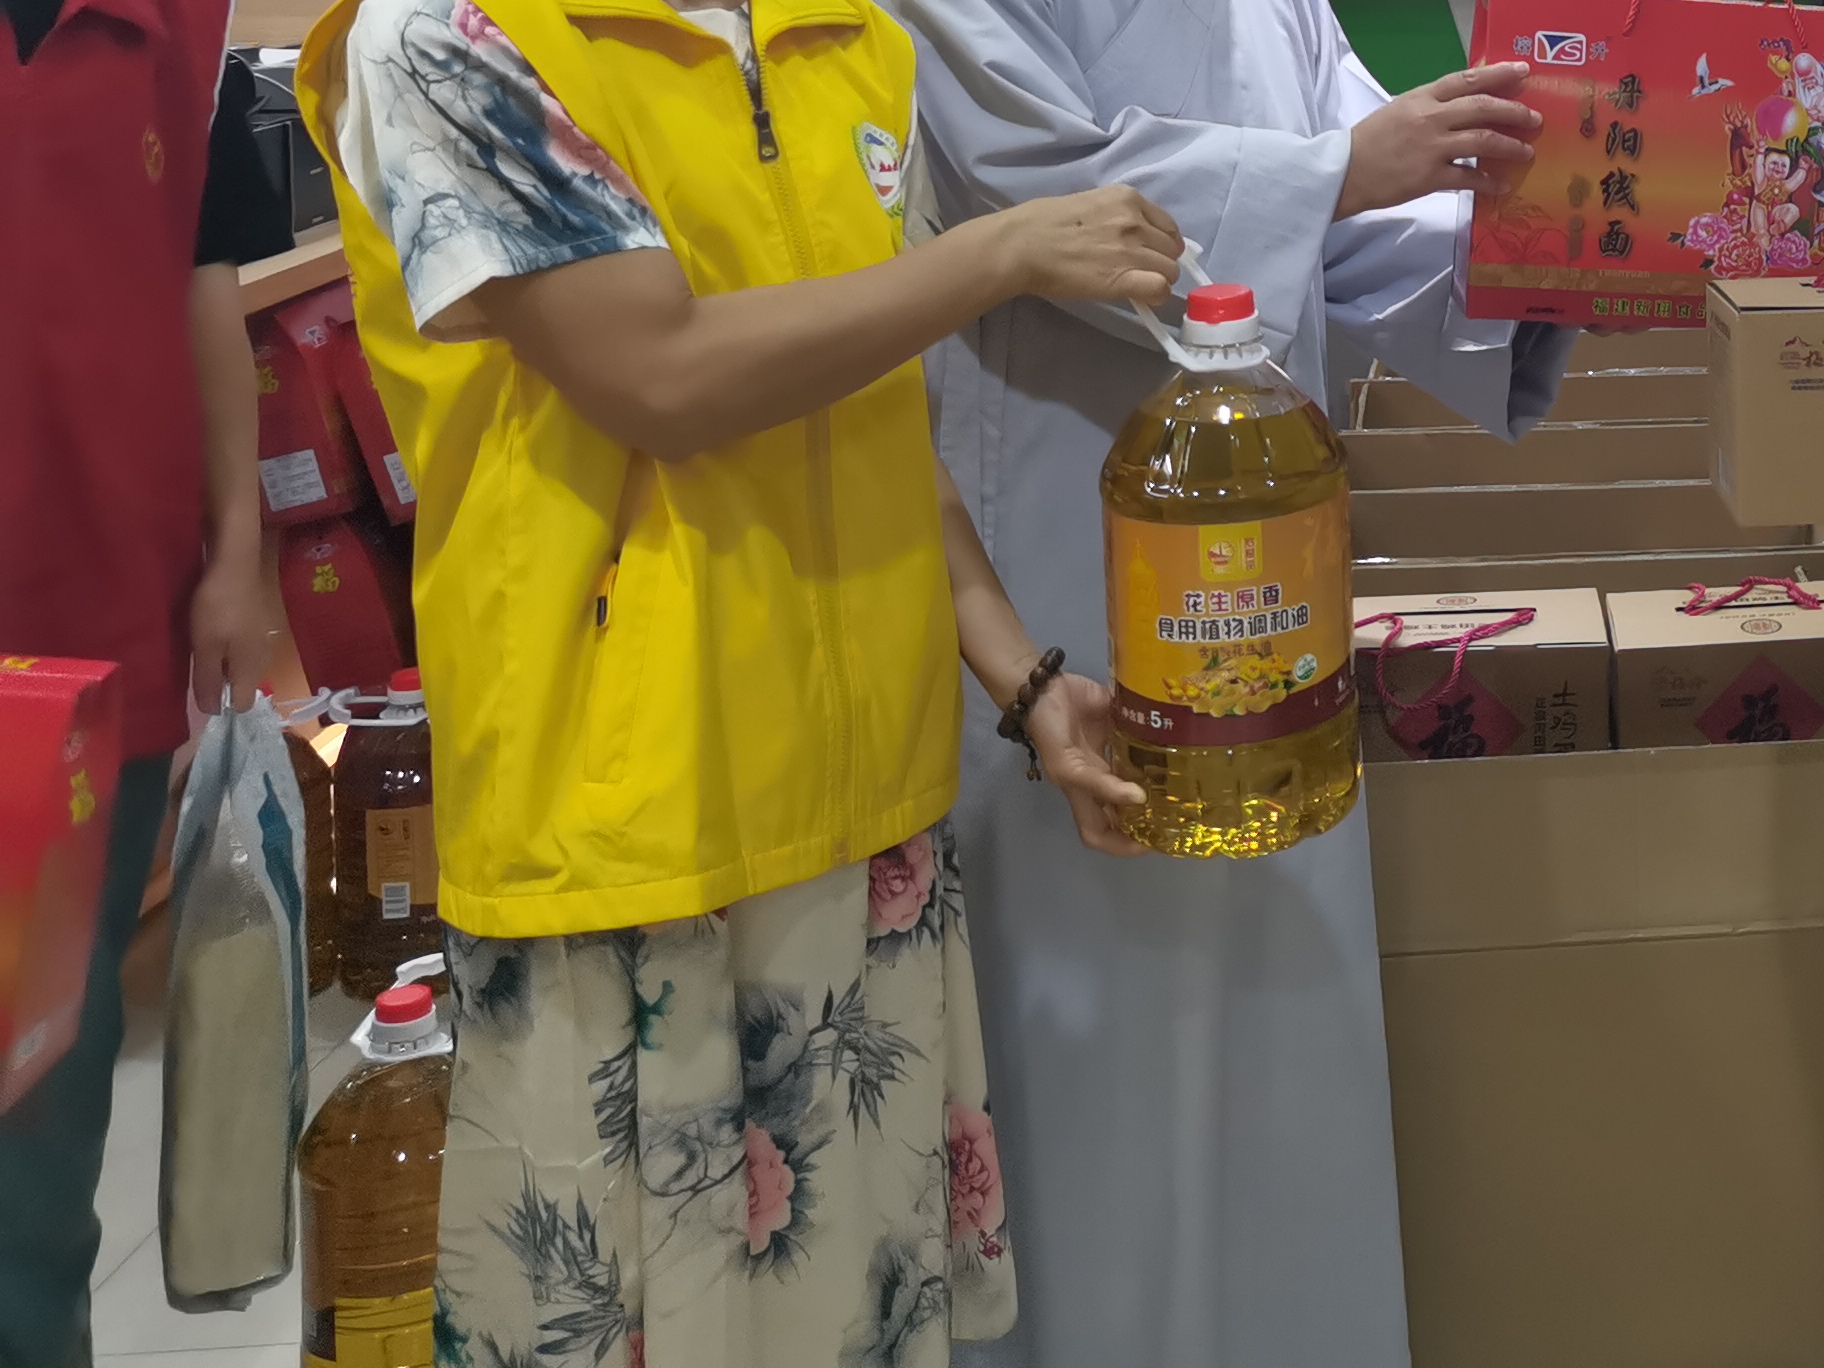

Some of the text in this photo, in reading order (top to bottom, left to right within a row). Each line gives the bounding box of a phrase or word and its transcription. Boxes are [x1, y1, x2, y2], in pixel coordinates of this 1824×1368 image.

[1598, 72, 1644, 260] 丹阳线面
[1183, 583, 1282, 614] 花生原香
[1157, 603, 1311, 643] 食用植物调和油
